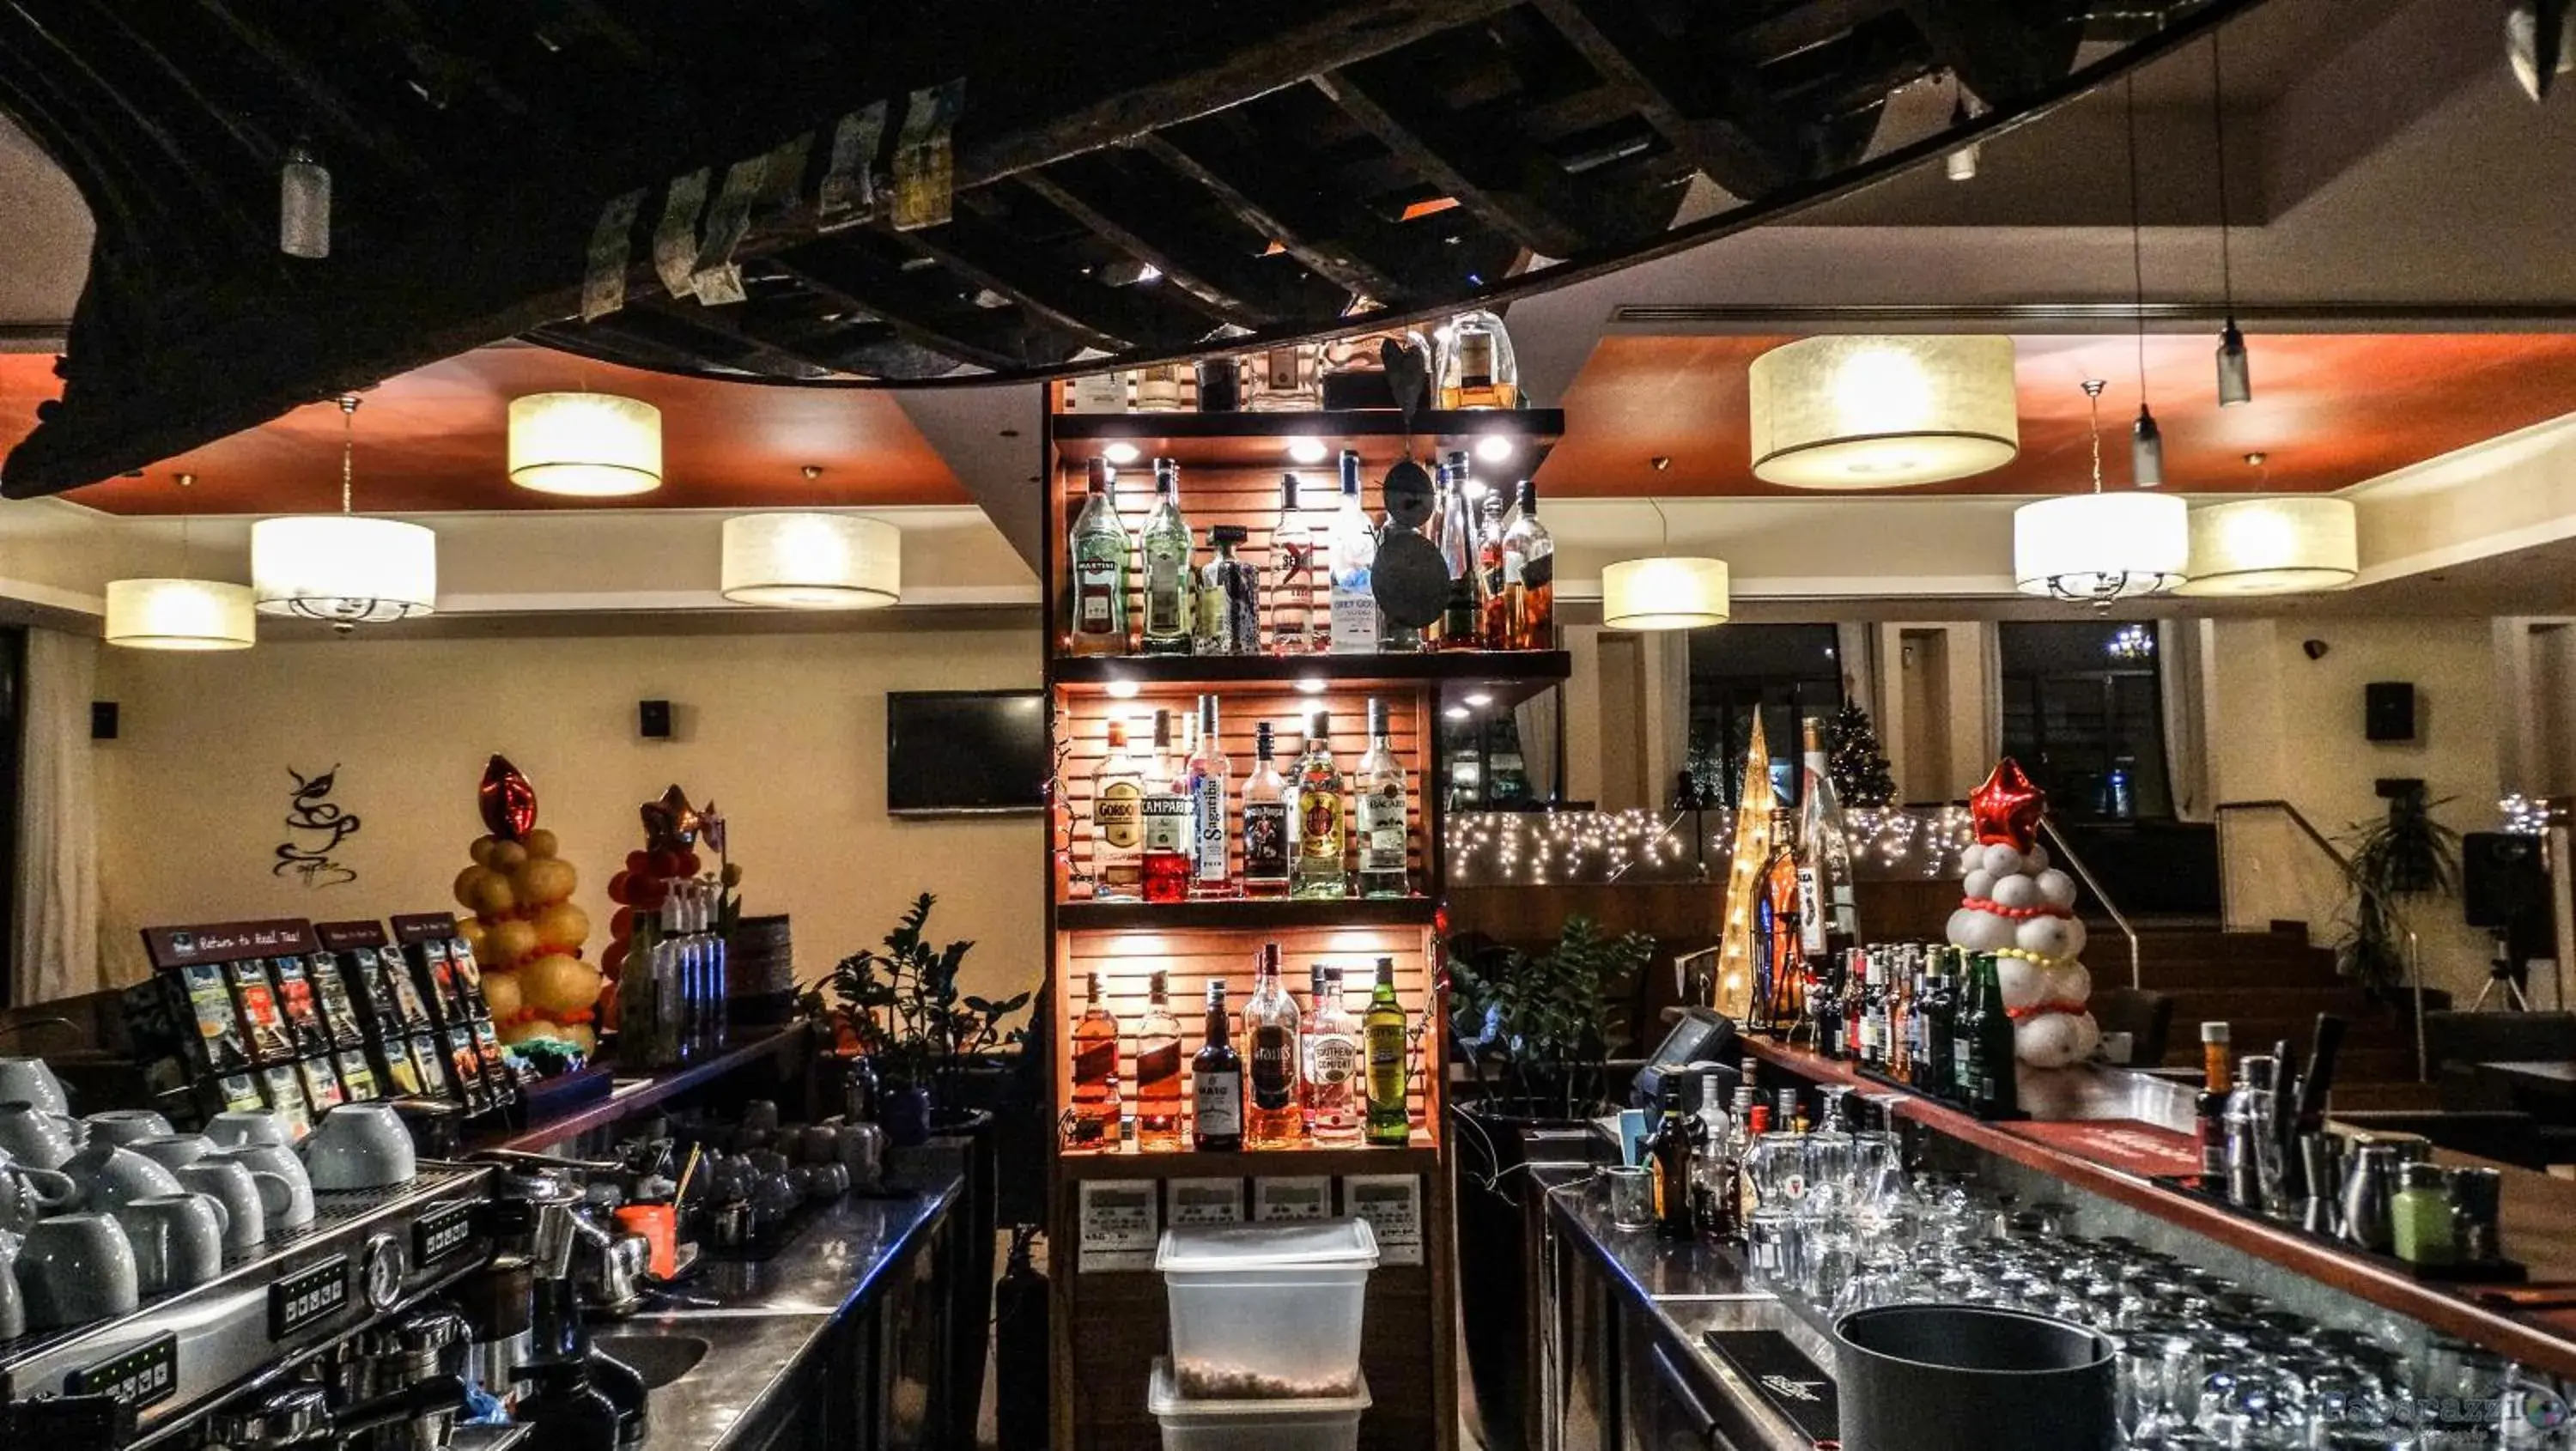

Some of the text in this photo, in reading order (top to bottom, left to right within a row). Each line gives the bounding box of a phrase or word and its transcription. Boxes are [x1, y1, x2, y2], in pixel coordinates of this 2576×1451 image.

[1078, 562, 1115, 570] MARTINI
[1141, 800, 1185, 814] CAMPARI
[1203, 780, 1222, 841] Sagatiba
[239, 933, 251, 946] to
